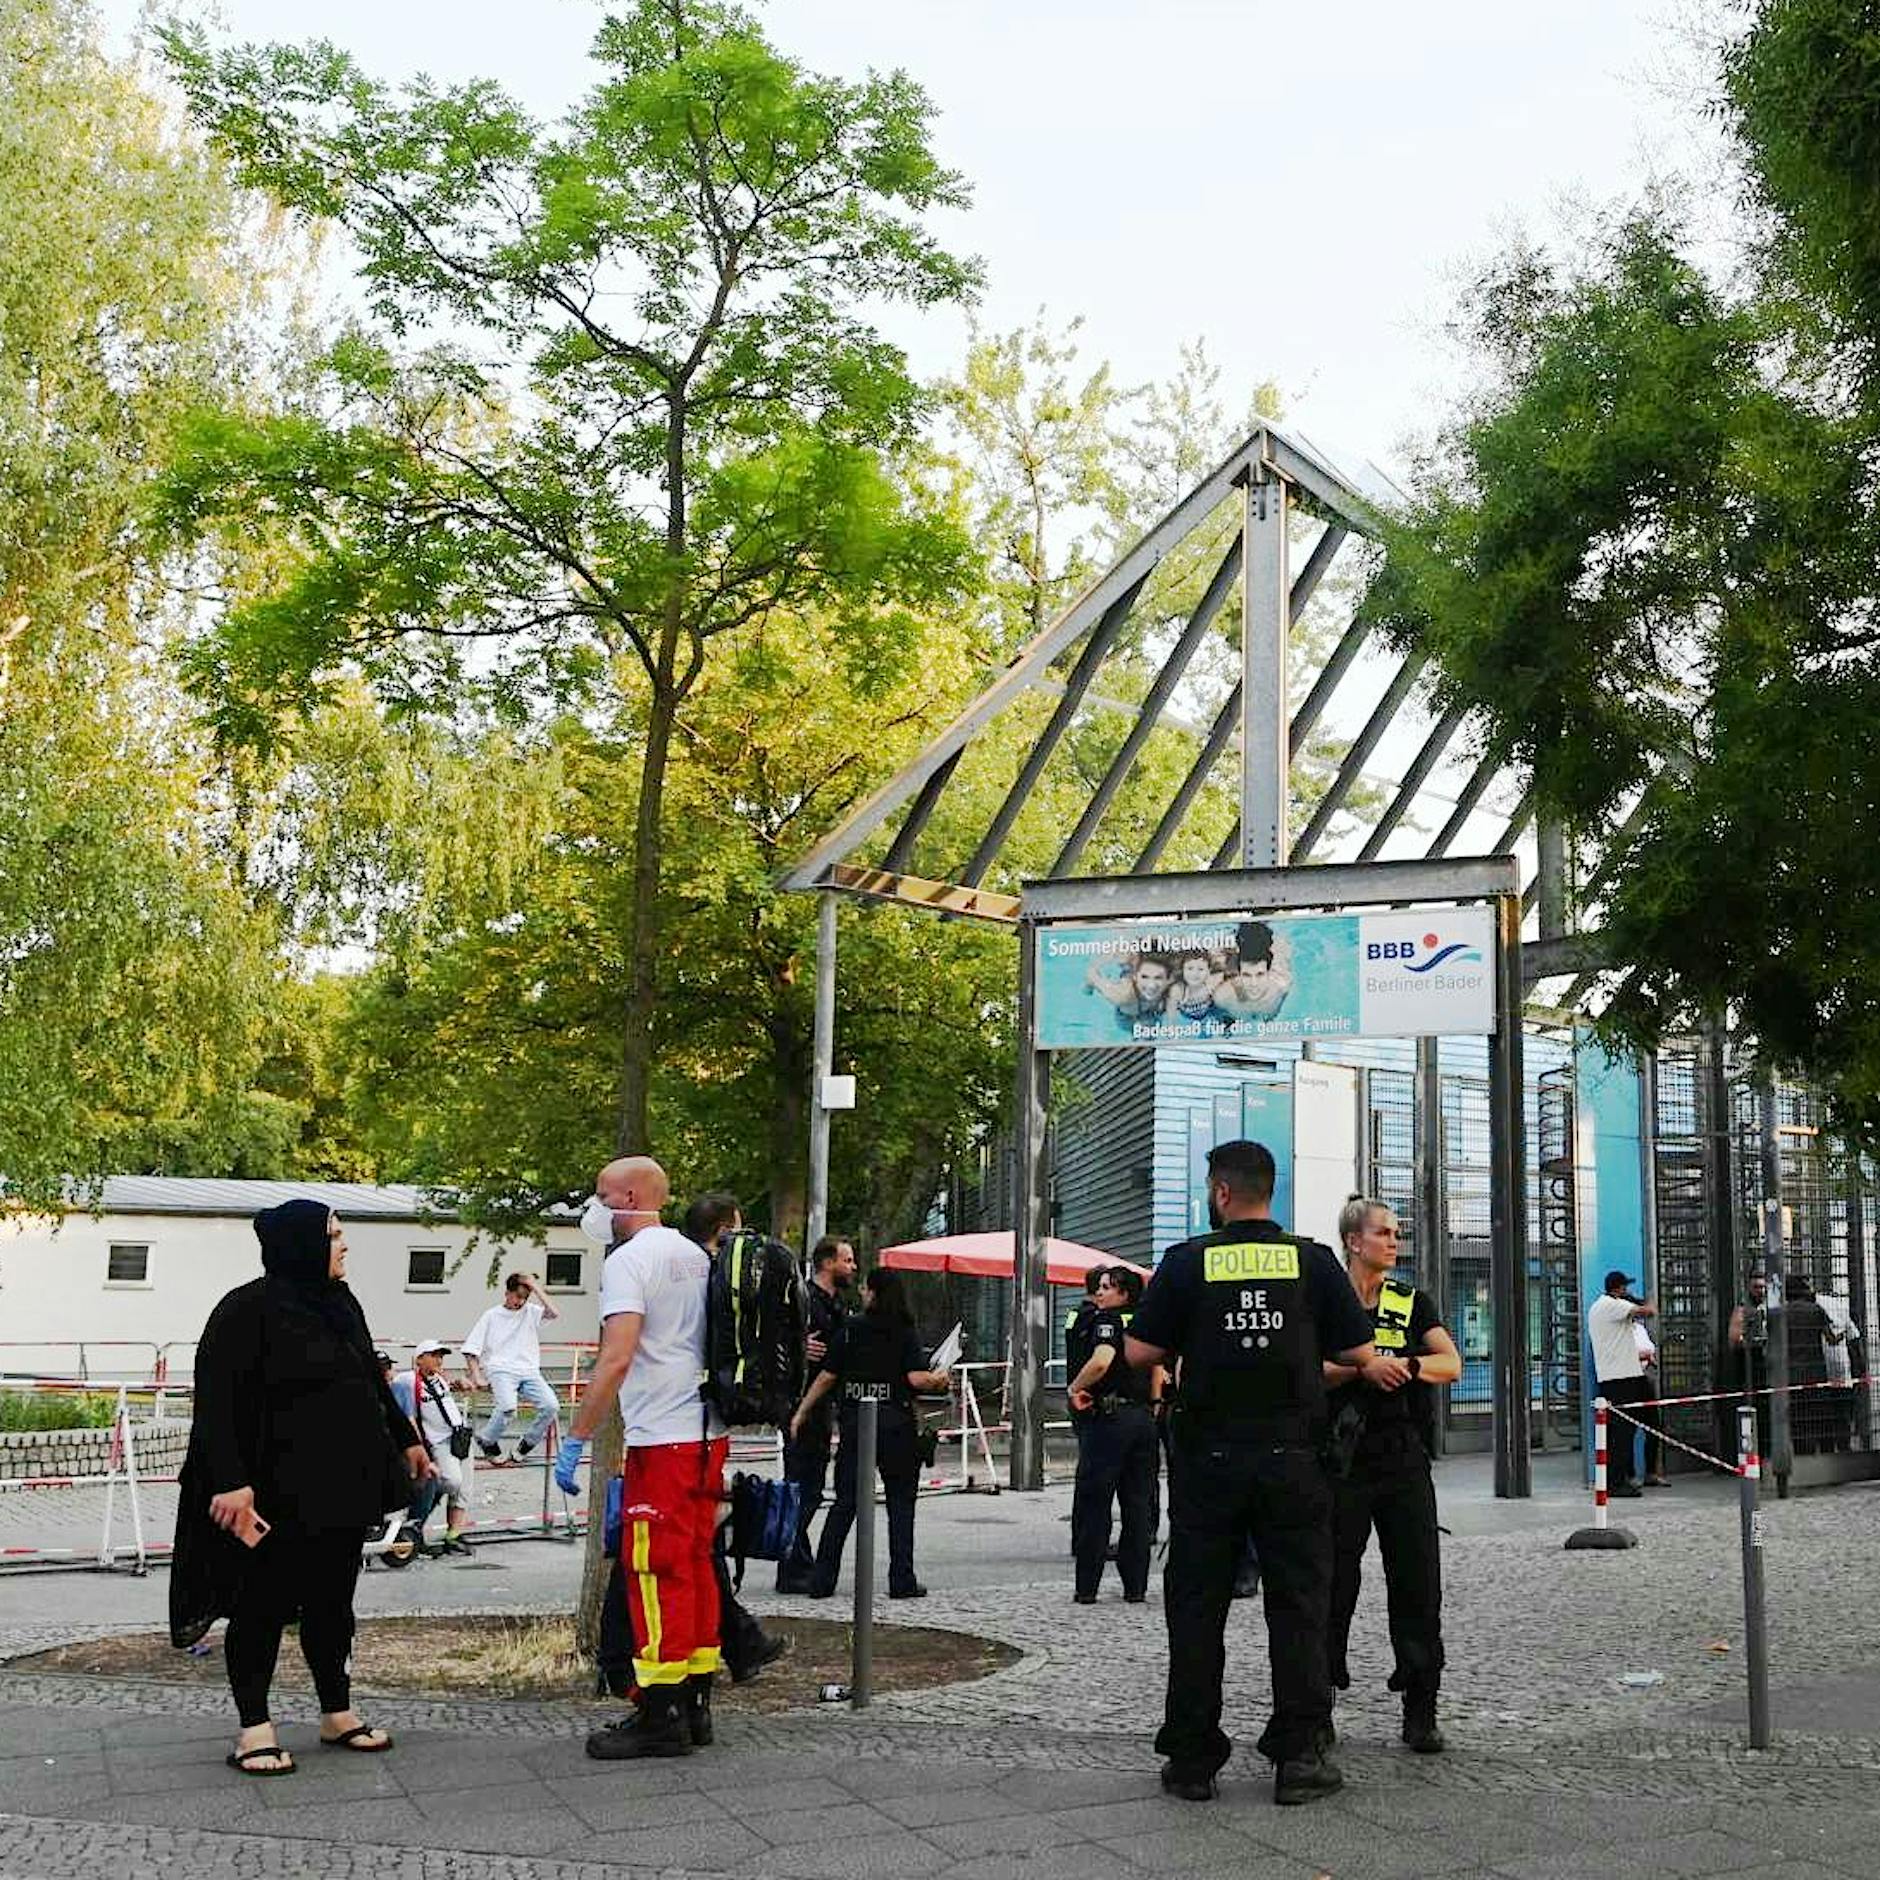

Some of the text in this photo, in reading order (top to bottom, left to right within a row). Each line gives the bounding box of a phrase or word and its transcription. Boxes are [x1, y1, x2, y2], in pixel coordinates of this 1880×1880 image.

[1049, 930, 1237, 957] Sommerbad Neukölln
[1367, 942, 1415, 960] BBB
[1367, 974, 1482, 992] Berliner Bäder
[1133, 1015, 1352, 1039] Badespaß für die ganze Familie
[1210, 1248, 1294, 1276] POLIZEI
[1241, 1290, 1267, 1309] BE
[1224, 1311, 1283, 1331] 15130
[845, 1382, 890, 1400] POLIZEI
